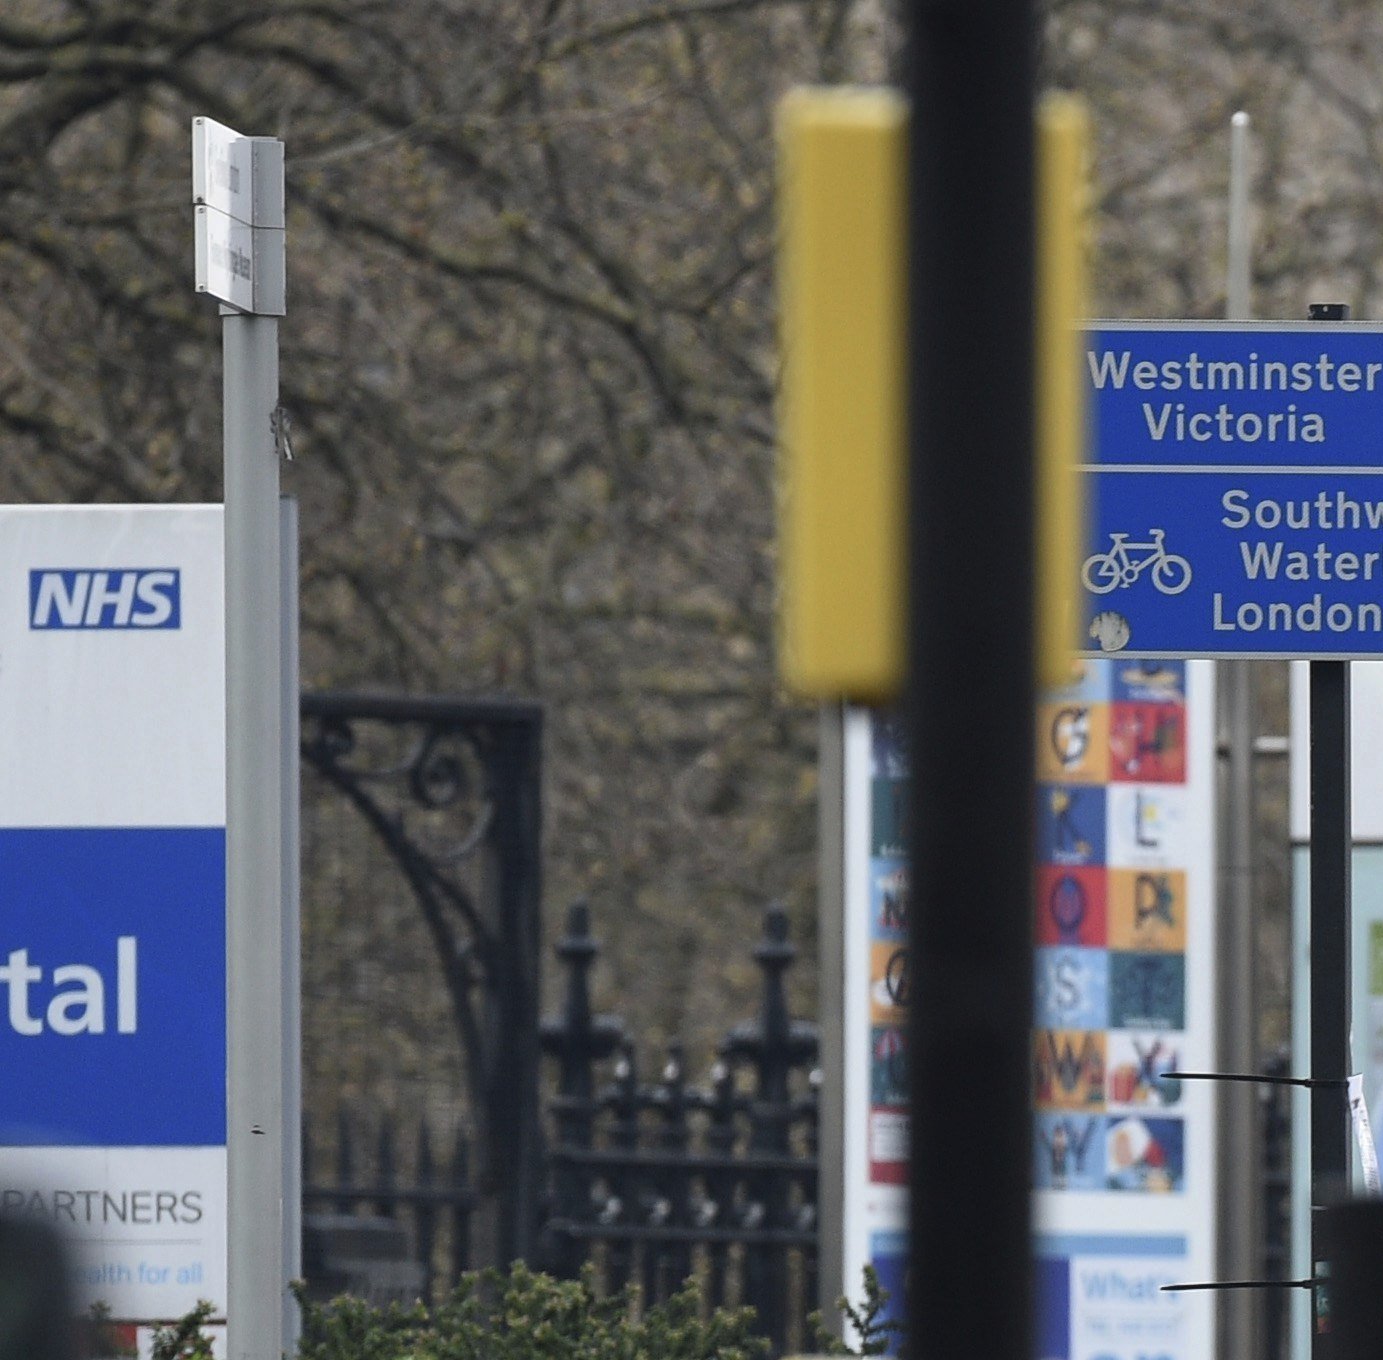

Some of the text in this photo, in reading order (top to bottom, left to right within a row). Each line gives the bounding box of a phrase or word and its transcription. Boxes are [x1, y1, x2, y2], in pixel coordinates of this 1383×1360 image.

[1087, 351, 1383, 391] Westminster
[1142, 403, 1326, 442] Victoria
[32, 572, 176, 627] NHS
[1213, 593, 1382, 632] London
[0, 935, 137, 1036] tal
[3, 1190, 203, 1223] PARTNERS
[138, 1262, 170, 1284] for
[176, 1262, 204, 1285] all
